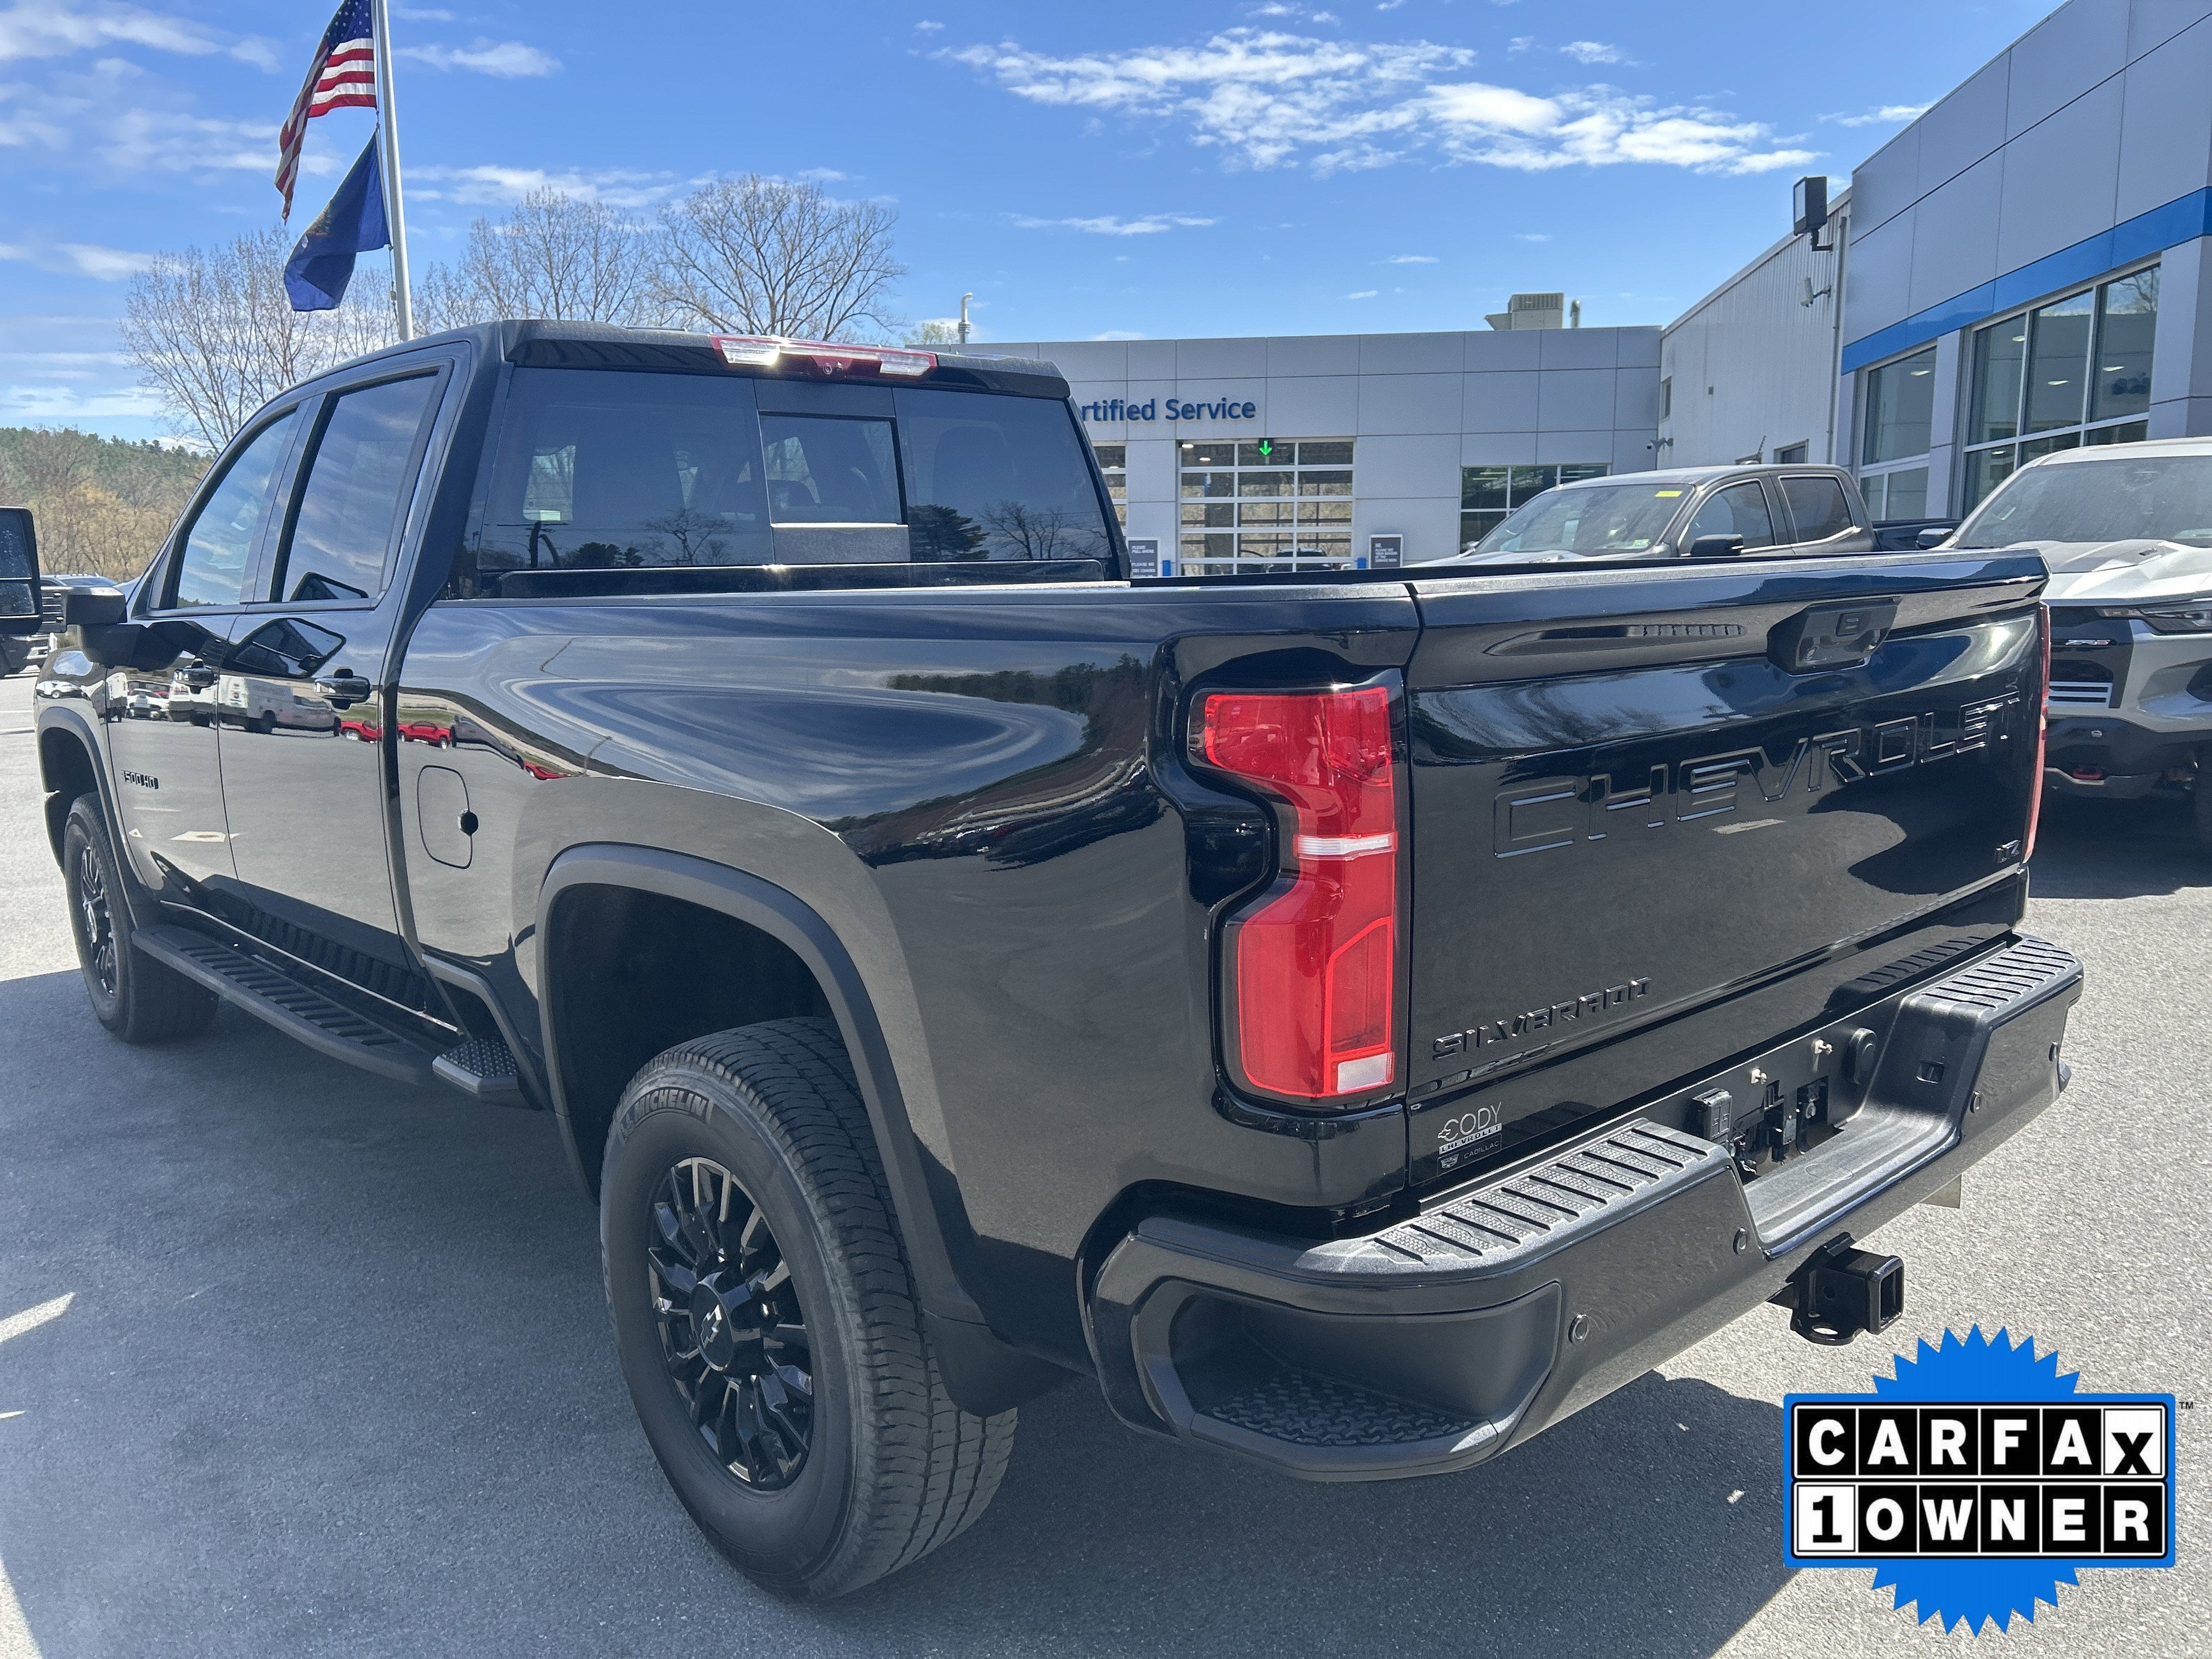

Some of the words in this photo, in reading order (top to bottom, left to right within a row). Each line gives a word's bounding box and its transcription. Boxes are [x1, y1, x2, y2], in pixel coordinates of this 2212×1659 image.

[1165, 397, 1256, 420] Service
[1494, 691, 2020, 857] CHEVROLET
[1432, 977, 1652, 1060] SILVERADO
[634, 1089, 707, 1122] MICHELIN
[1440, 1101, 1502, 1141] CODY
[1441, 1125, 1500, 1152] CHEVROLET
[1464, 1141, 1499, 1159] CADILLAC
